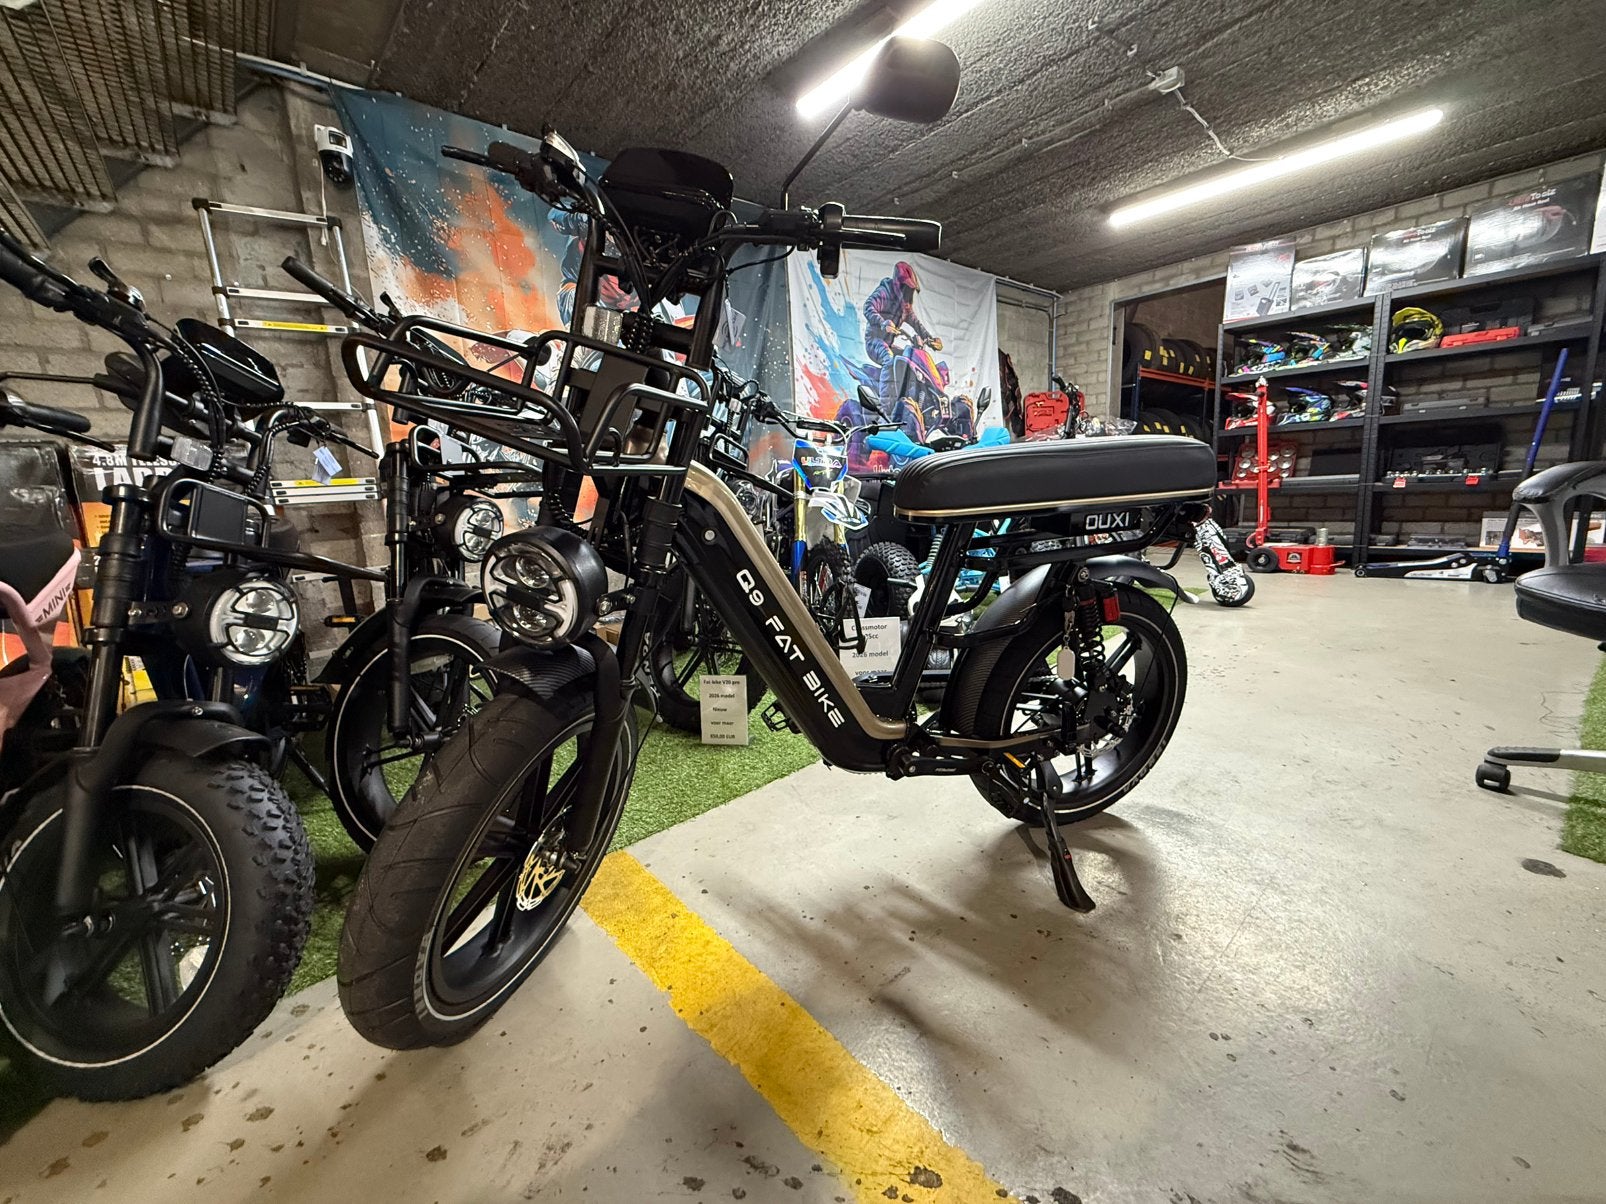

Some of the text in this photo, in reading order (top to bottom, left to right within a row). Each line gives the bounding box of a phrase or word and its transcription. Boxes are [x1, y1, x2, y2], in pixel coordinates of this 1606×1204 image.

[1086, 512, 1130, 530] OUXI
[42, 587, 66, 619] MINI
[736, 568, 845, 728] Q9 FAT BIKE
